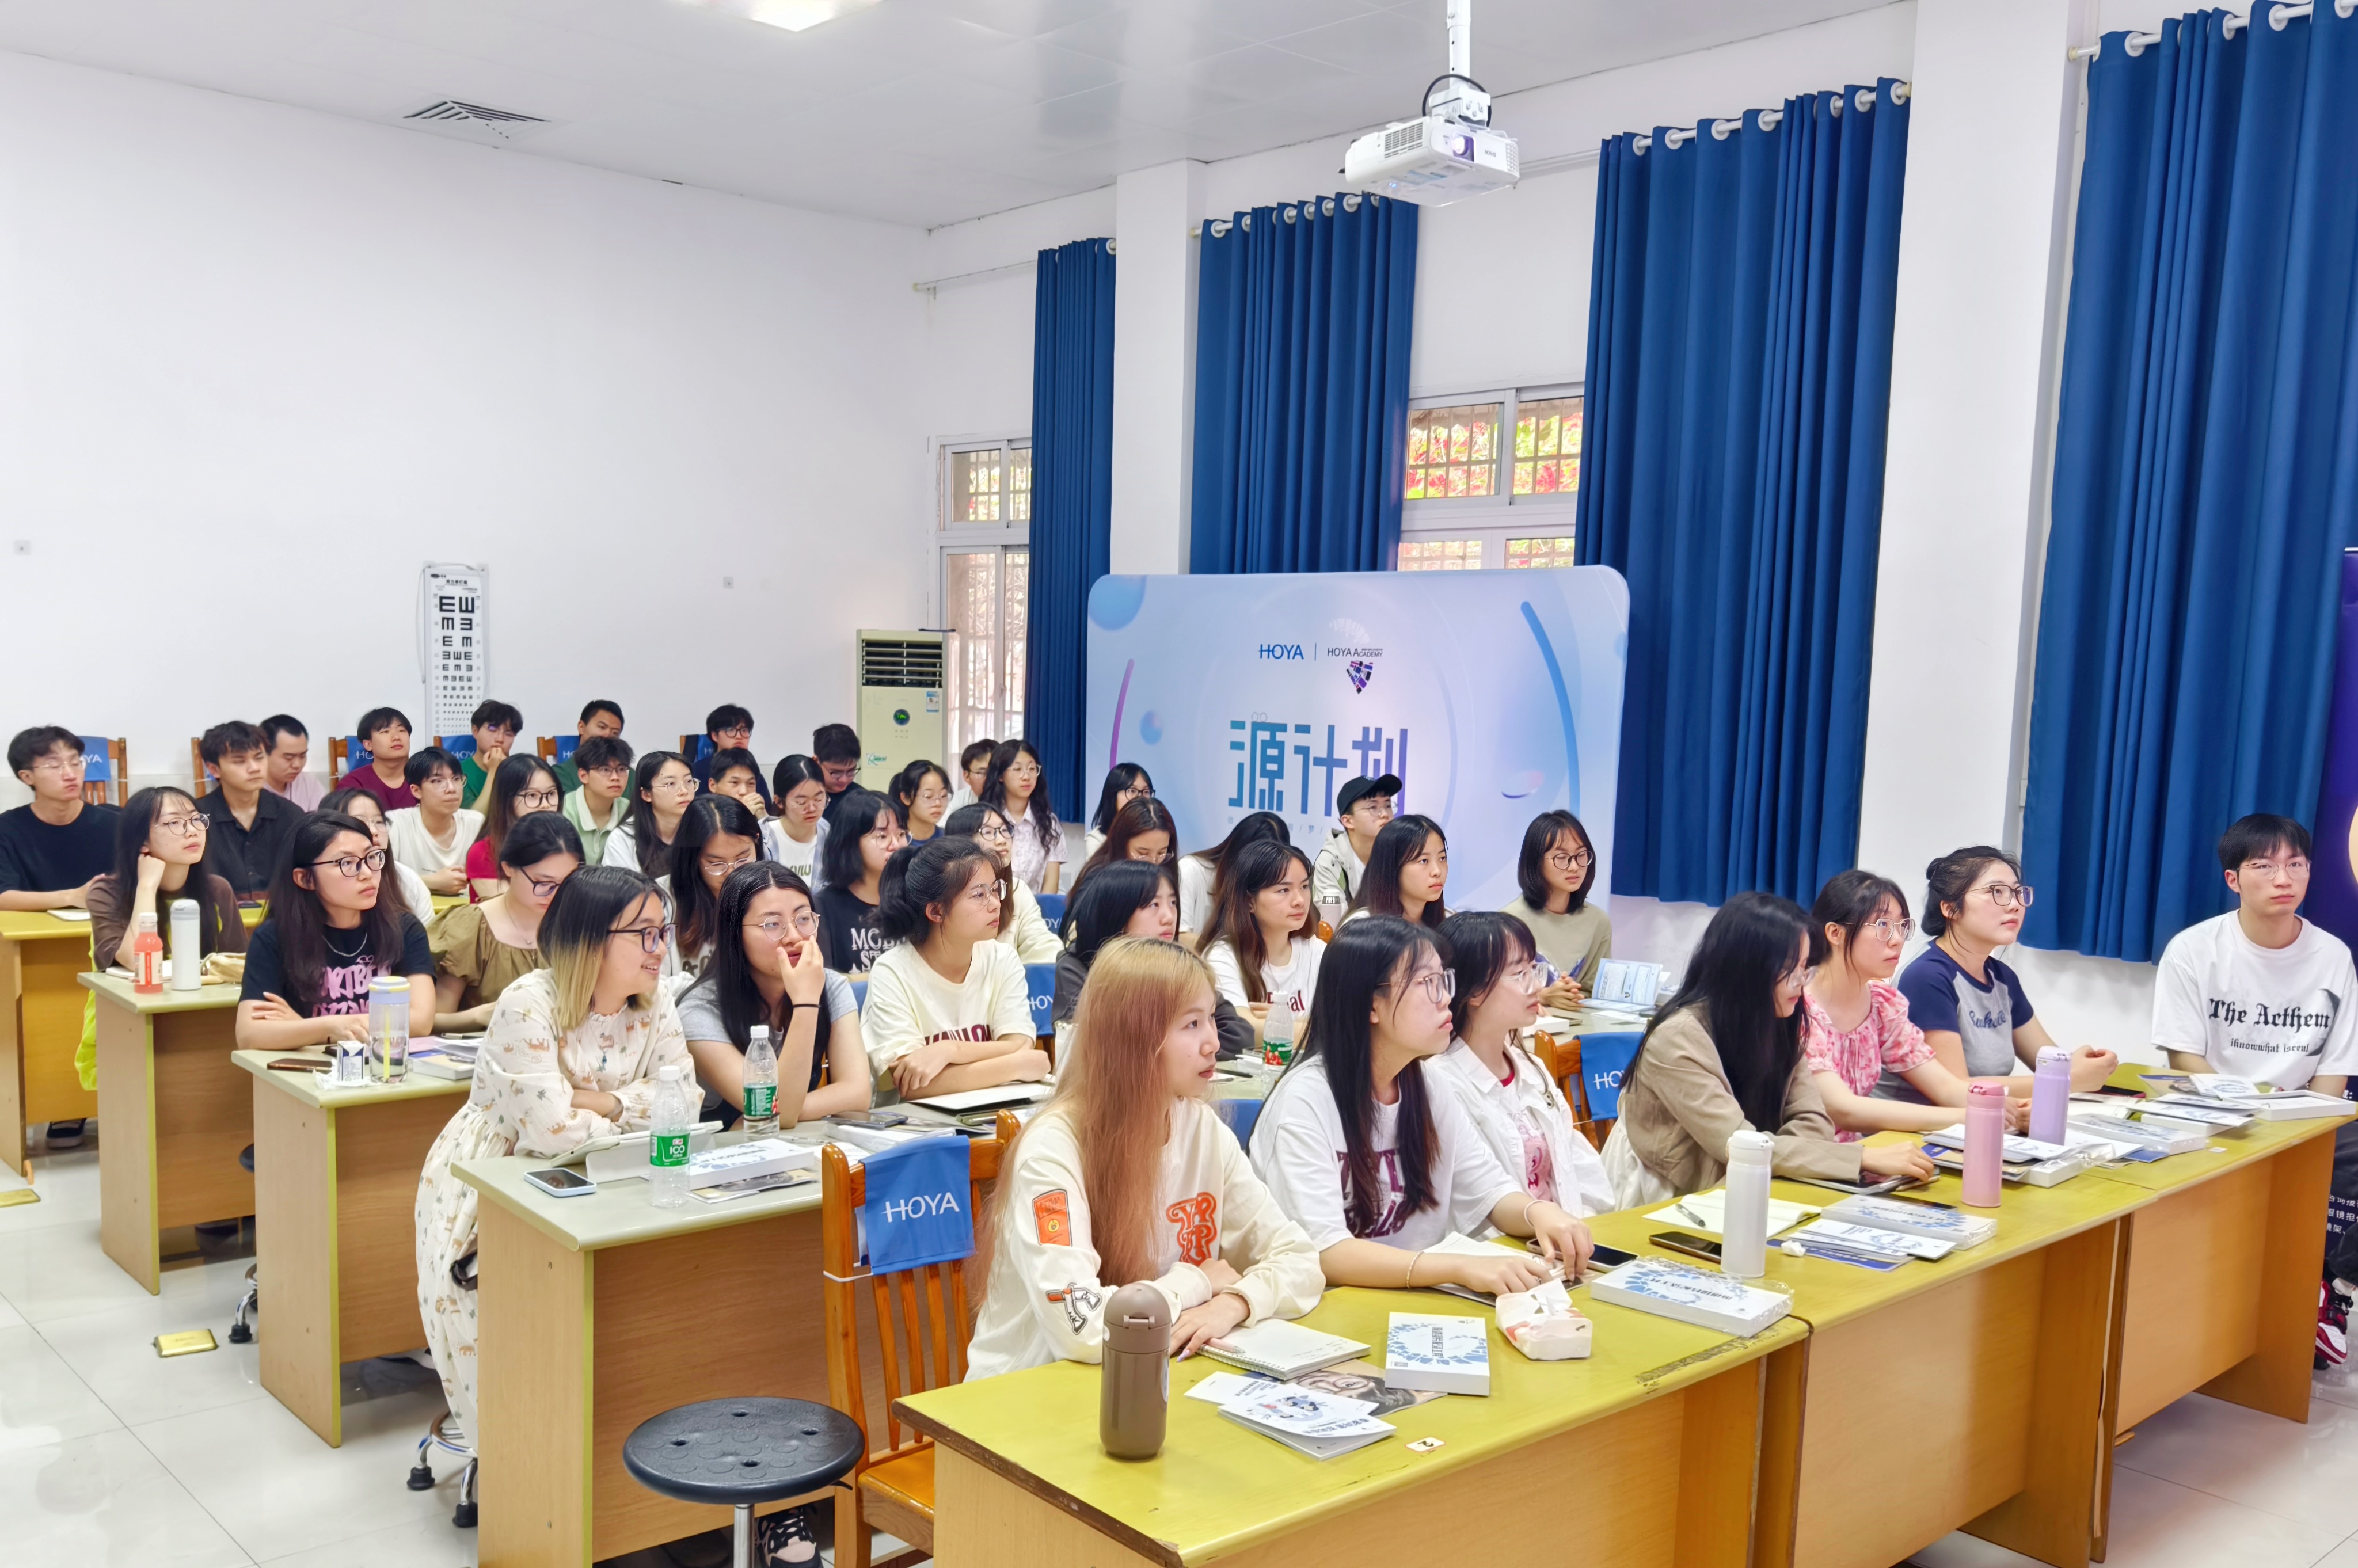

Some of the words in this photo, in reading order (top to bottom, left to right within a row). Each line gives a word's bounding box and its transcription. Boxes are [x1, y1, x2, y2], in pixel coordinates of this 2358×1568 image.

[1258, 644, 1304, 660] HOYA
[1328, 648, 1351, 657] HOYA
[84, 754, 102, 763] YA
[1228, 720, 1408, 818] 源计划
[1044, 918, 1062, 928] OY
[2209, 998, 2247, 1027] The
[1592, 1070, 1625, 1090] HO
[881, 1192, 960, 1223] HOYA
